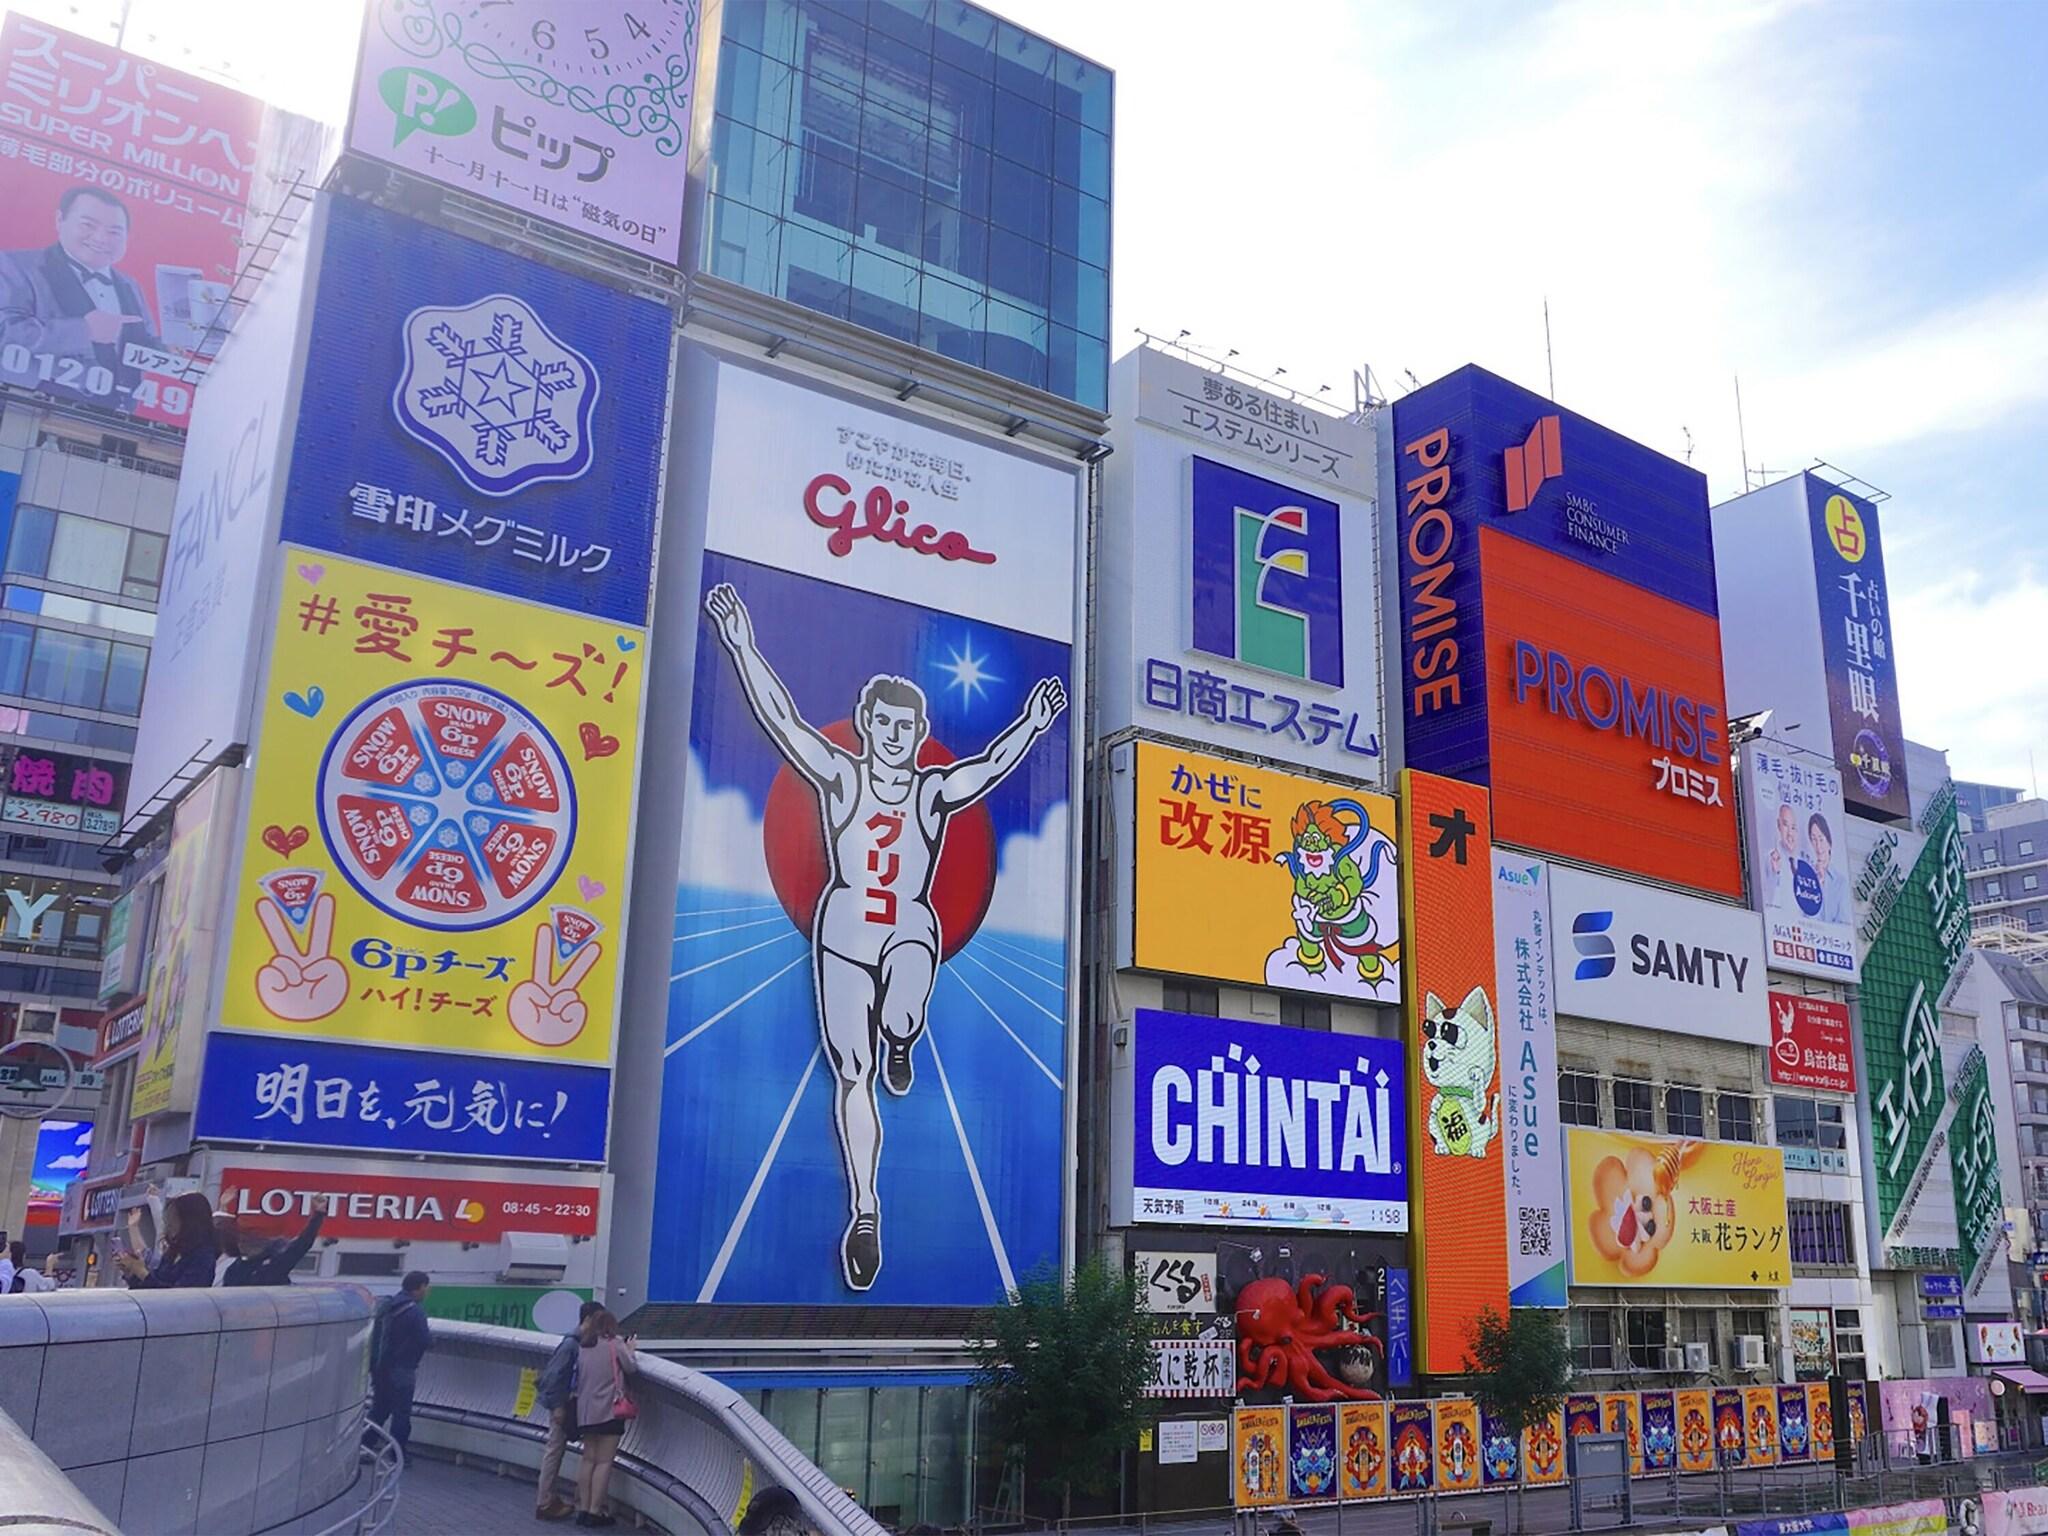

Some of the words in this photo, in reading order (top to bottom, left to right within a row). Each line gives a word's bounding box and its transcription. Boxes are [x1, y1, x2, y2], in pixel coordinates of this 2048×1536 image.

[531, 20, 556, 50] 6
[584, 28, 609, 59] 5
[623, 12, 651, 40] 4
[13, 22, 200, 103] スーパー
[0, 103, 112, 153] SUPER
[123, 141, 240, 195] MILLION
[491, 105, 615, 183] ピップ
[1202, 376, 1320, 437] 夢ある住まい
[1182, 405, 1340, 480] エステムシリーズ
[846, 451, 959, 501] ゆたかな人生
[349, 481, 612, 573] 雪印メグミルク
[803, 473, 997, 565] Glico
[1566, 491, 1598, 516] SMBC
[1567, 507, 1631, 545] CONSUMER
[1834, 498, 1860, 557] 占
[1568, 521, 1618, 554] FINANCE
[1404, 427, 1461, 718] PROMISE
[1838, 571, 1880, 723] 千里眼
[434, 702, 493, 726] SNOW
[1145, 656, 1380, 759] 日商エステム
[1515, 638, 1721, 766] PROMISE
[352, 717, 397, 768] SNOW
[440, 744, 476, 758] CHEESE
[10, 756, 114, 804] 焼肉
[394, 755, 421, 783] CHEESE
[492, 769, 512, 802] CHEESE
[520, 748, 555, 800] SNOW
[1170, 763, 1263, 810] かぜに
[1651, 756, 1724, 807] プロミス
[343, 808, 381, 864] SNOW
[391, 806, 411, 840] CHEESE
[485, 824, 508, 853] CHEESE
[1159, 798, 1273, 865] 改源
[1429, 807, 1476, 866] オ
[429, 851, 464, 864] CHEESE
[507, 838, 547, 889] SNOW
[864, 809, 906, 926] グリコ
[1498, 866, 1528, 885] Asue
[1856, 830, 1898, 902] いい暮らし
[1928, 822, 1962, 929] エイブル
[5, 889, 60, 940] Y
[410, 885, 471, 906] SNOW
[1862, 863, 1906, 941] いい部屋で
[1630, 932, 1749, 994] SAMTY
[360, 987, 498, 1017] ハイ!チーズ
[254, 1063, 569, 1139] 明日を、元気に!
[1878, 979, 1940, 1179] エイブル
[1152, 1042, 1391, 1174] CHINTAI
[1507, 1084, 1522, 1196] に変わりました。
[1957, 1087, 1996, 1205] エイブル
[237, 1188, 445, 1222] LOTTERIA
[1143, 1197, 1185, 1215] 天気予報
[1688, 1196, 1737, 1218] 大阪土産
